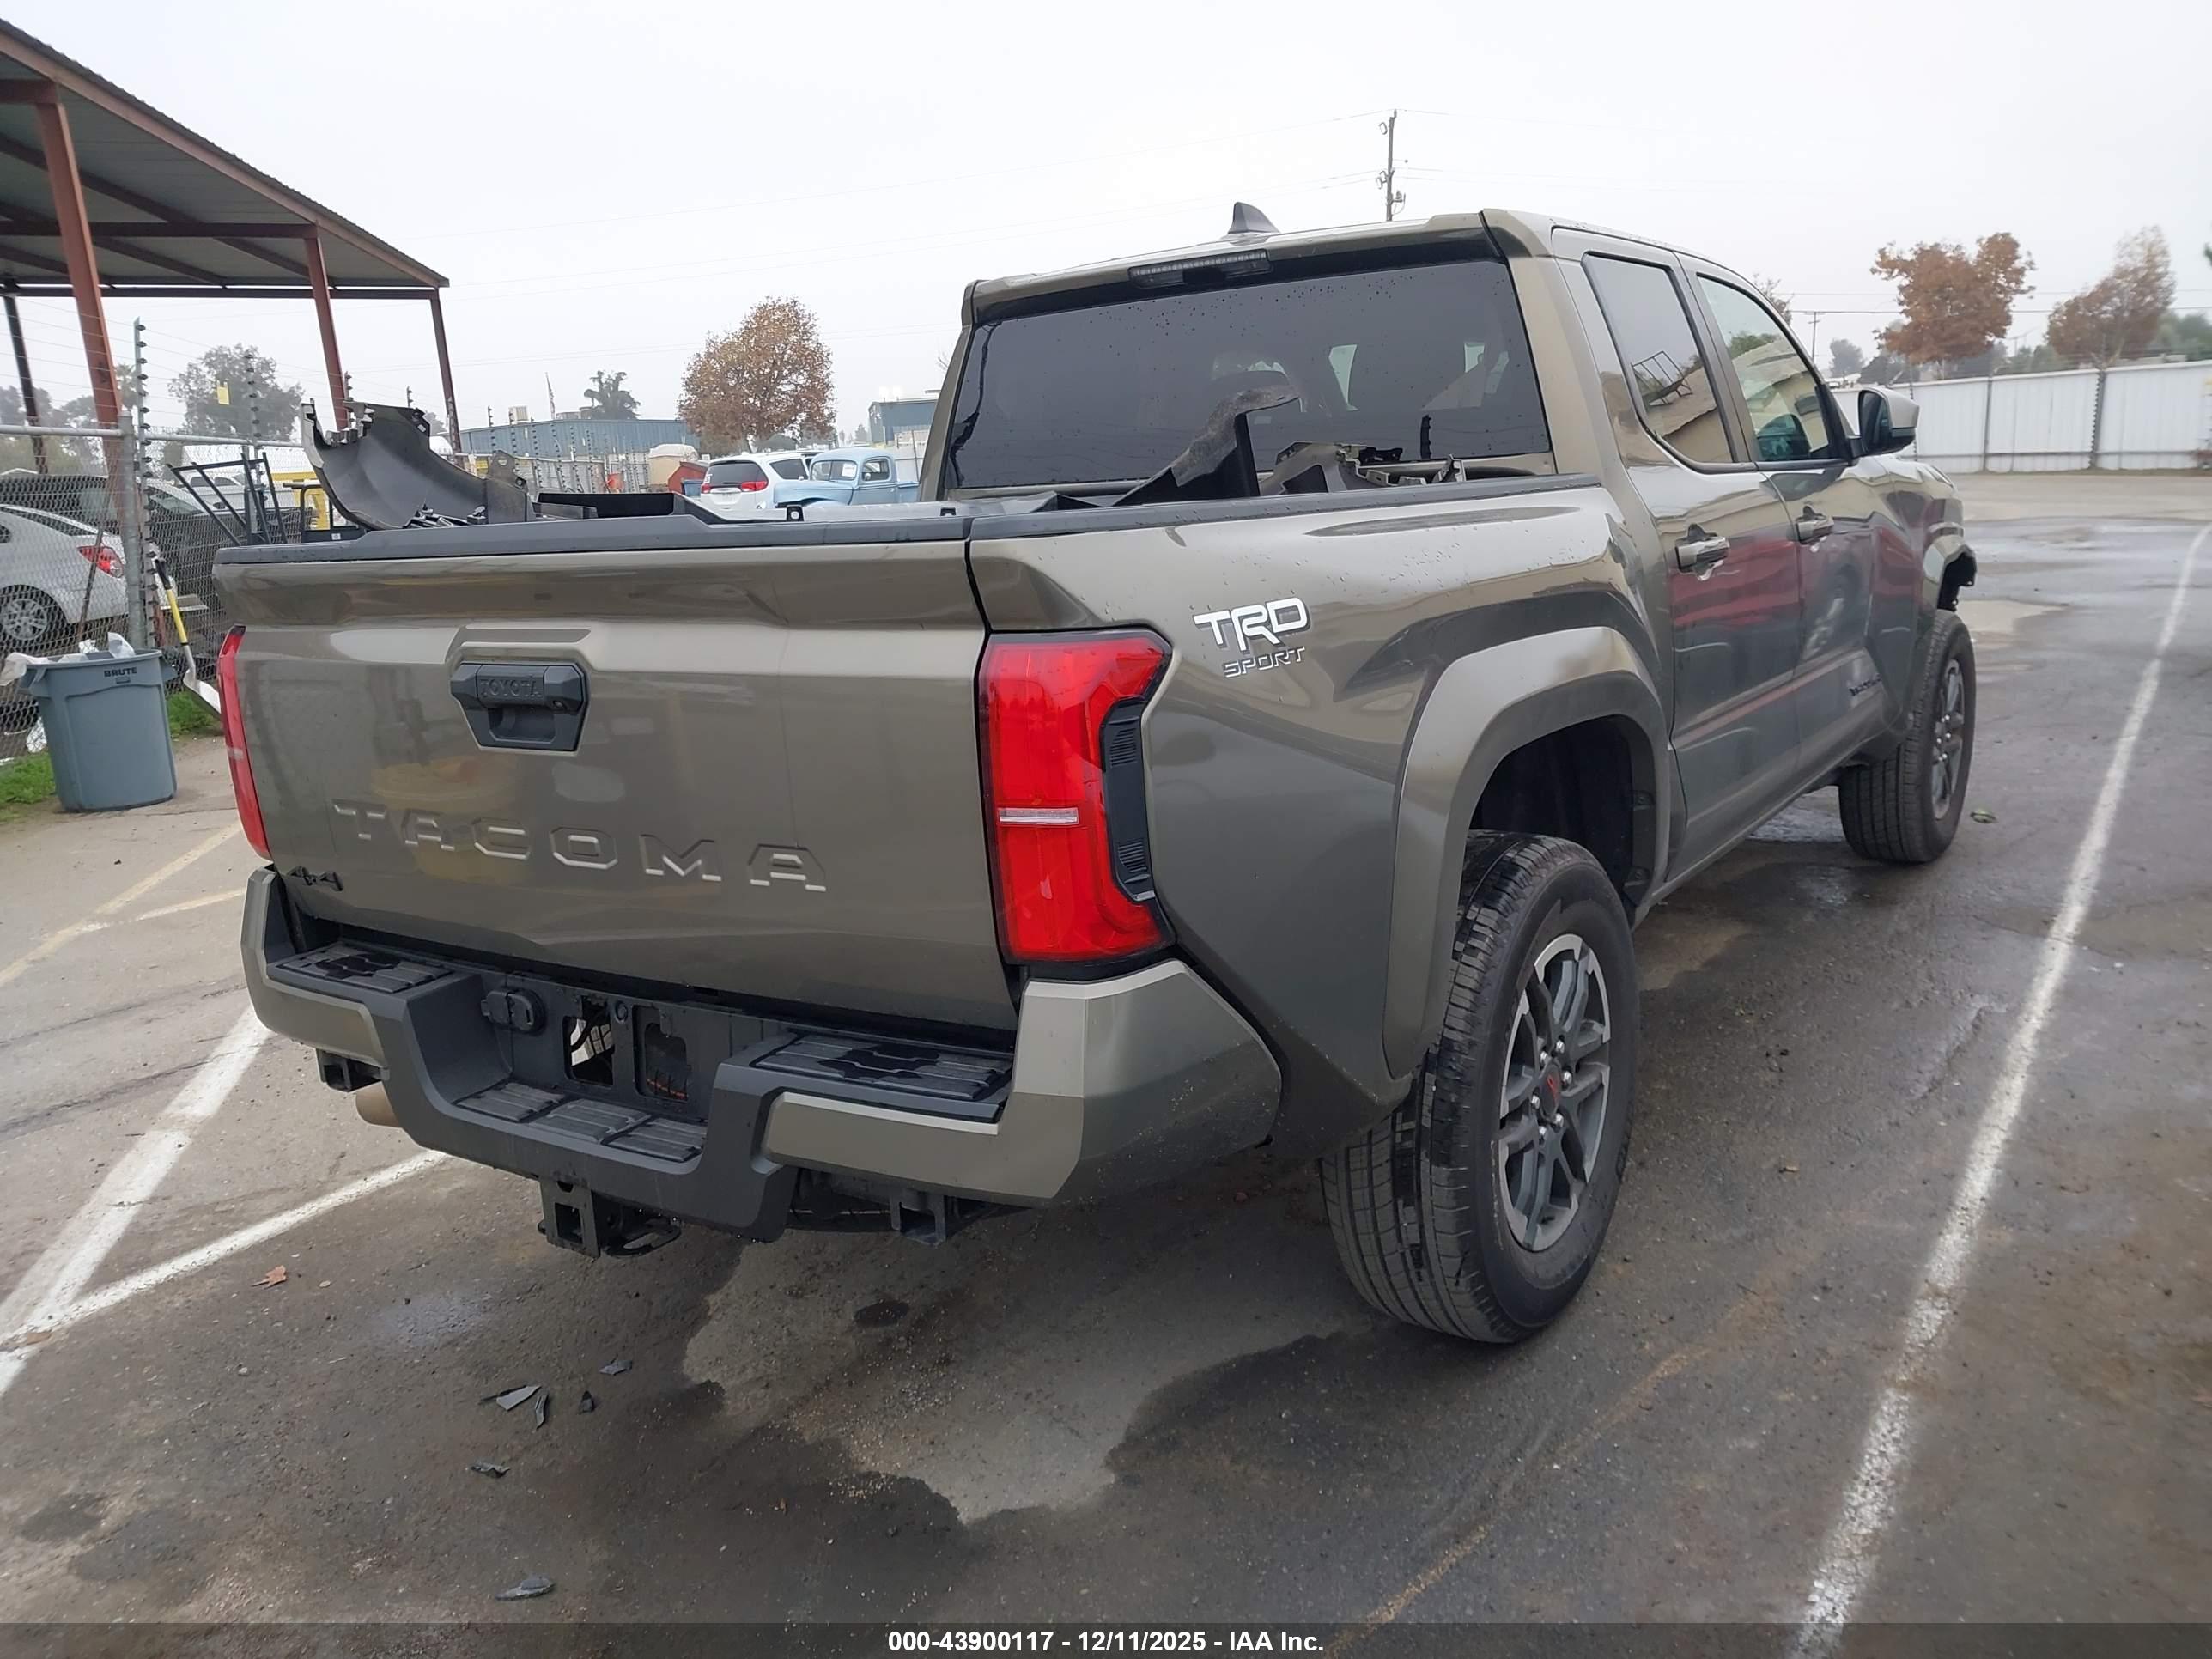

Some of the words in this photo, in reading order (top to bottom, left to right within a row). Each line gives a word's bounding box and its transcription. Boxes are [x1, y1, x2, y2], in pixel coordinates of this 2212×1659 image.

[1193, 598, 1311, 654] TRD
[104, 666, 137, 678] BRUTE
[1224, 646, 1306, 678] SPORT
[480, 678, 544, 699] TOYOTA
[332, 798, 827, 893] TACOMA
